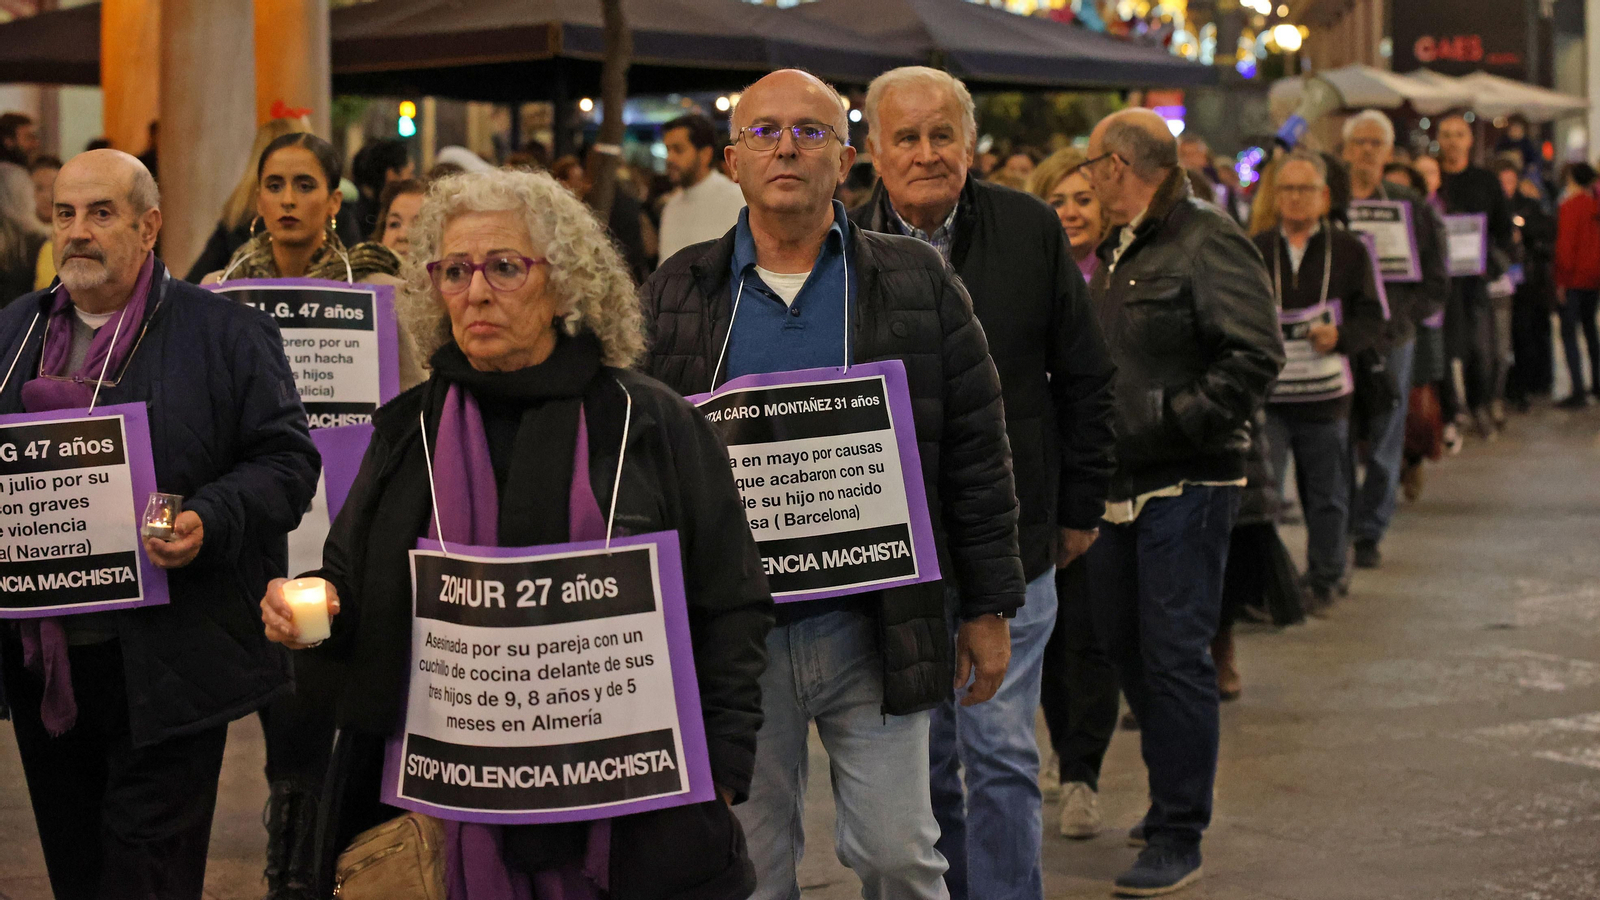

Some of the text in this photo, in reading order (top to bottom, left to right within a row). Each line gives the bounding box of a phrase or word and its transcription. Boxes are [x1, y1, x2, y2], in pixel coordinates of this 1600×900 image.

[298, 303, 320, 318] 47
[324, 303, 364, 320] años
[319, 338, 341, 349] por
[344, 338, 360, 348] un
[294, 355, 311, 364] un
[314, 352, 354, 364] hacha
[302, 368, 334, 381] hijos
[299, 385, 335, 398] alicia)
[723, 405, 760, 421] CARO
[764, 396, 833, 417] MONTAÑEZ
[834, 398, 848, 411] 31
[850, 394, 880, 408] años
[305, 412, 373, 428] ACHISTA
[24, 439, 51, 460] 47
[58, 436, 114, 457] años
[741, 455, 762, 467] en
[767, 449, 809, 466] mayo
[812, 447, 833, 464] por
[835, 440, 883, 458] causas
[9, 476, 47, 496] julio
[52, 474, 83, 491] por
[88, 472, 110, 484] su
[735, 461, 885, 491] que acabaron con su
[0, 497, 90, 516] on graves
[761, 496, 781, 508] su
[786, 490, 815, 507] hijo
[819, 488, 835, 502] no
[837, 482, 883, 499] nacido
[784, 504, 860, 527] Barcelona)
[8, 518, 87, 538] violencia
[16, 538, 92, 560] Navarra)
[761, 539, 911, 575] ENCIA MACHISTA
[37, 566, 136, 591] MACHISTA
[439, 573, 619, 609] ZOHUR 27 años
[425, 630, 644, 659] Asesinada por su pareja con un
[419, 653, 655, 682] cuchillo de cocina delante de sus
[428, 678, 637, 710] tres hijos de 9, 8 años y de 5
[446, 708, 602, 733] meses en Almería
[407, 749, 675, 789] STOP VIOLENCIA MACHISTA
